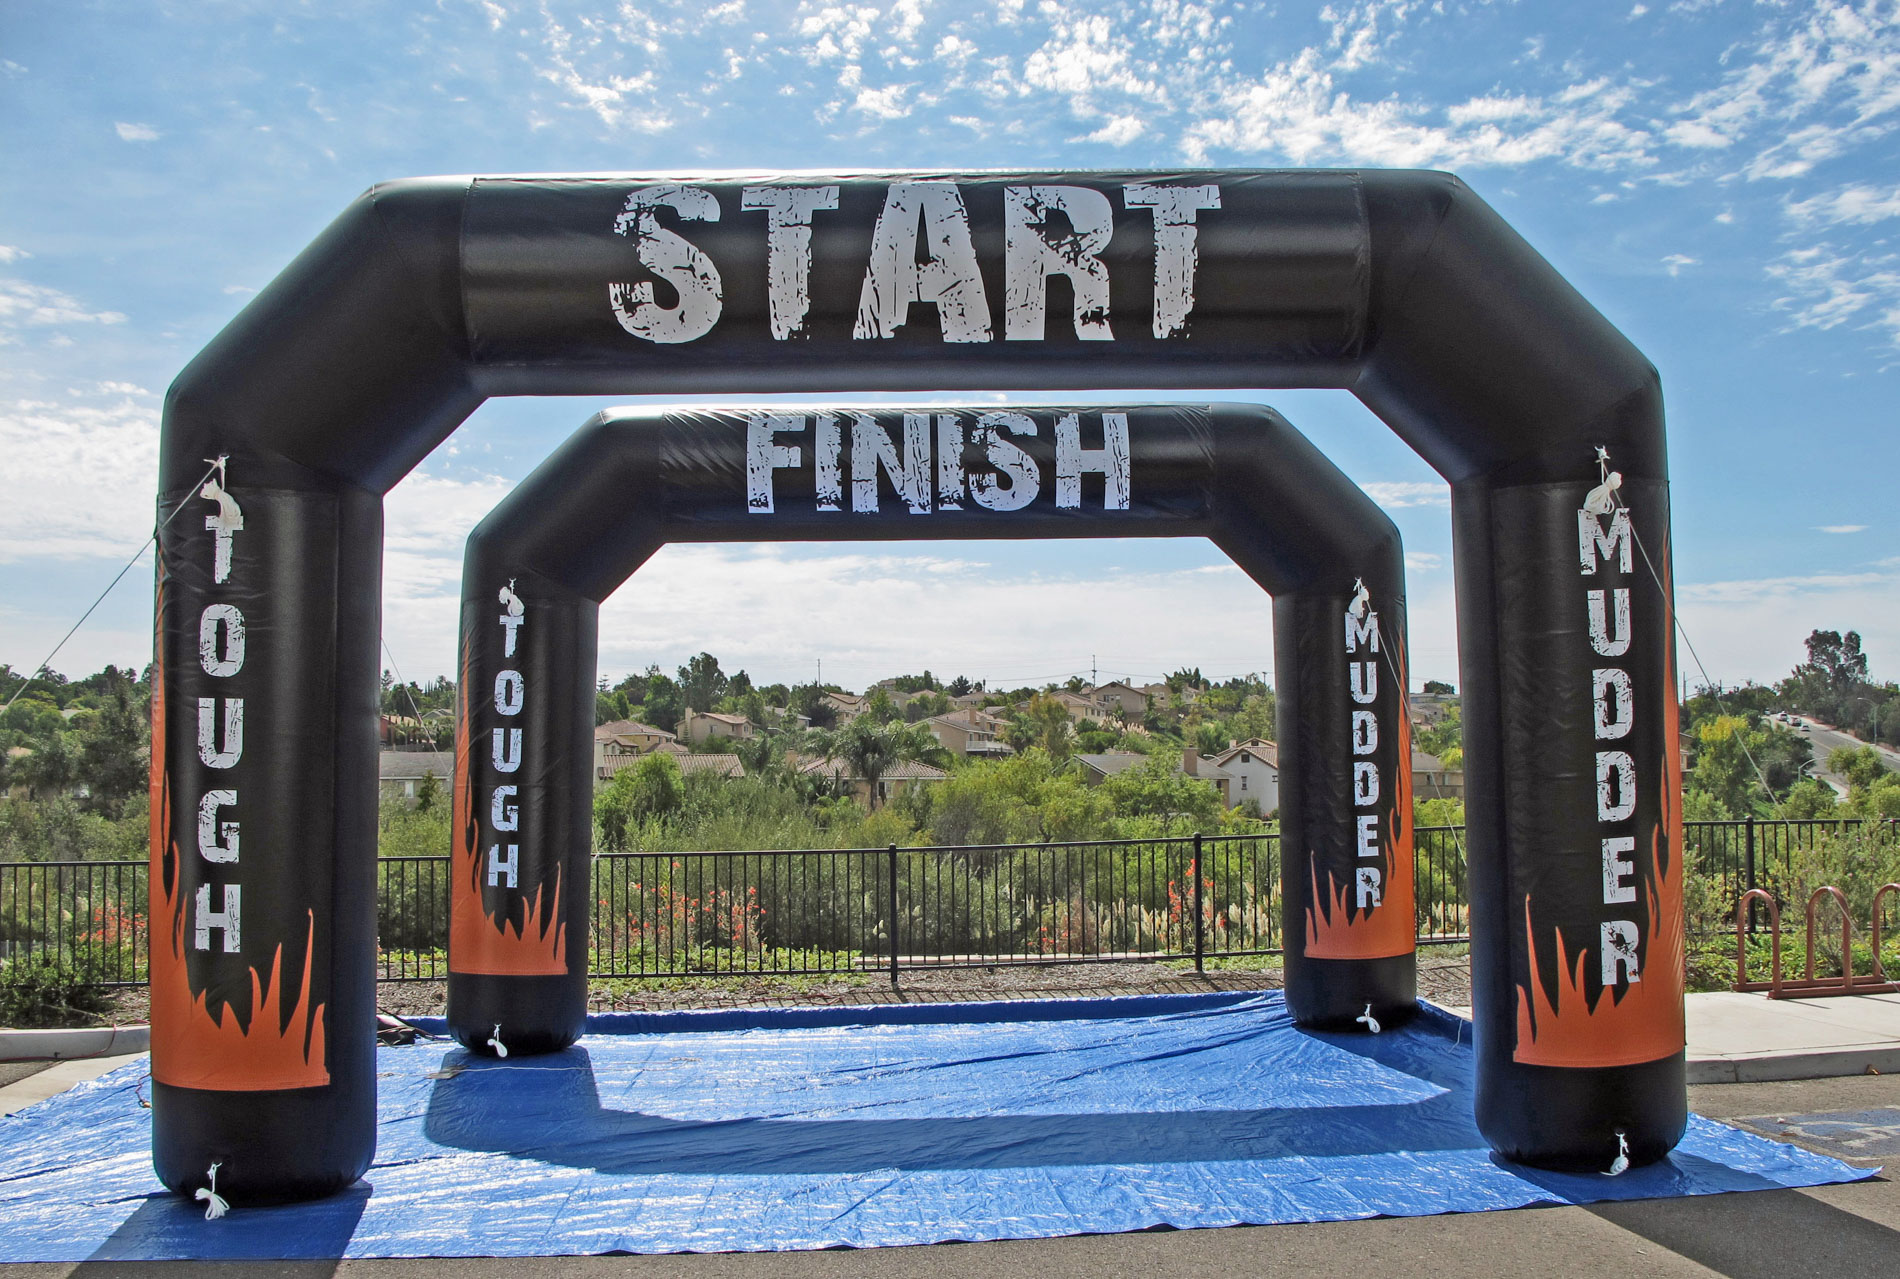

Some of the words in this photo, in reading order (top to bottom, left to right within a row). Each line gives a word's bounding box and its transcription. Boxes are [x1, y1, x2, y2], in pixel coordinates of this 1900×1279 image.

[609, 182, 1221, 343] START
[746, 413, 1131, 515] FINISH
[195, 515, 246, 953] TOUGH
[488, 615, 525, 889] TOUGH
[1344, 611, 1382, 909] MUDDER
[1577, 507, 1640, 986] MUDDER
